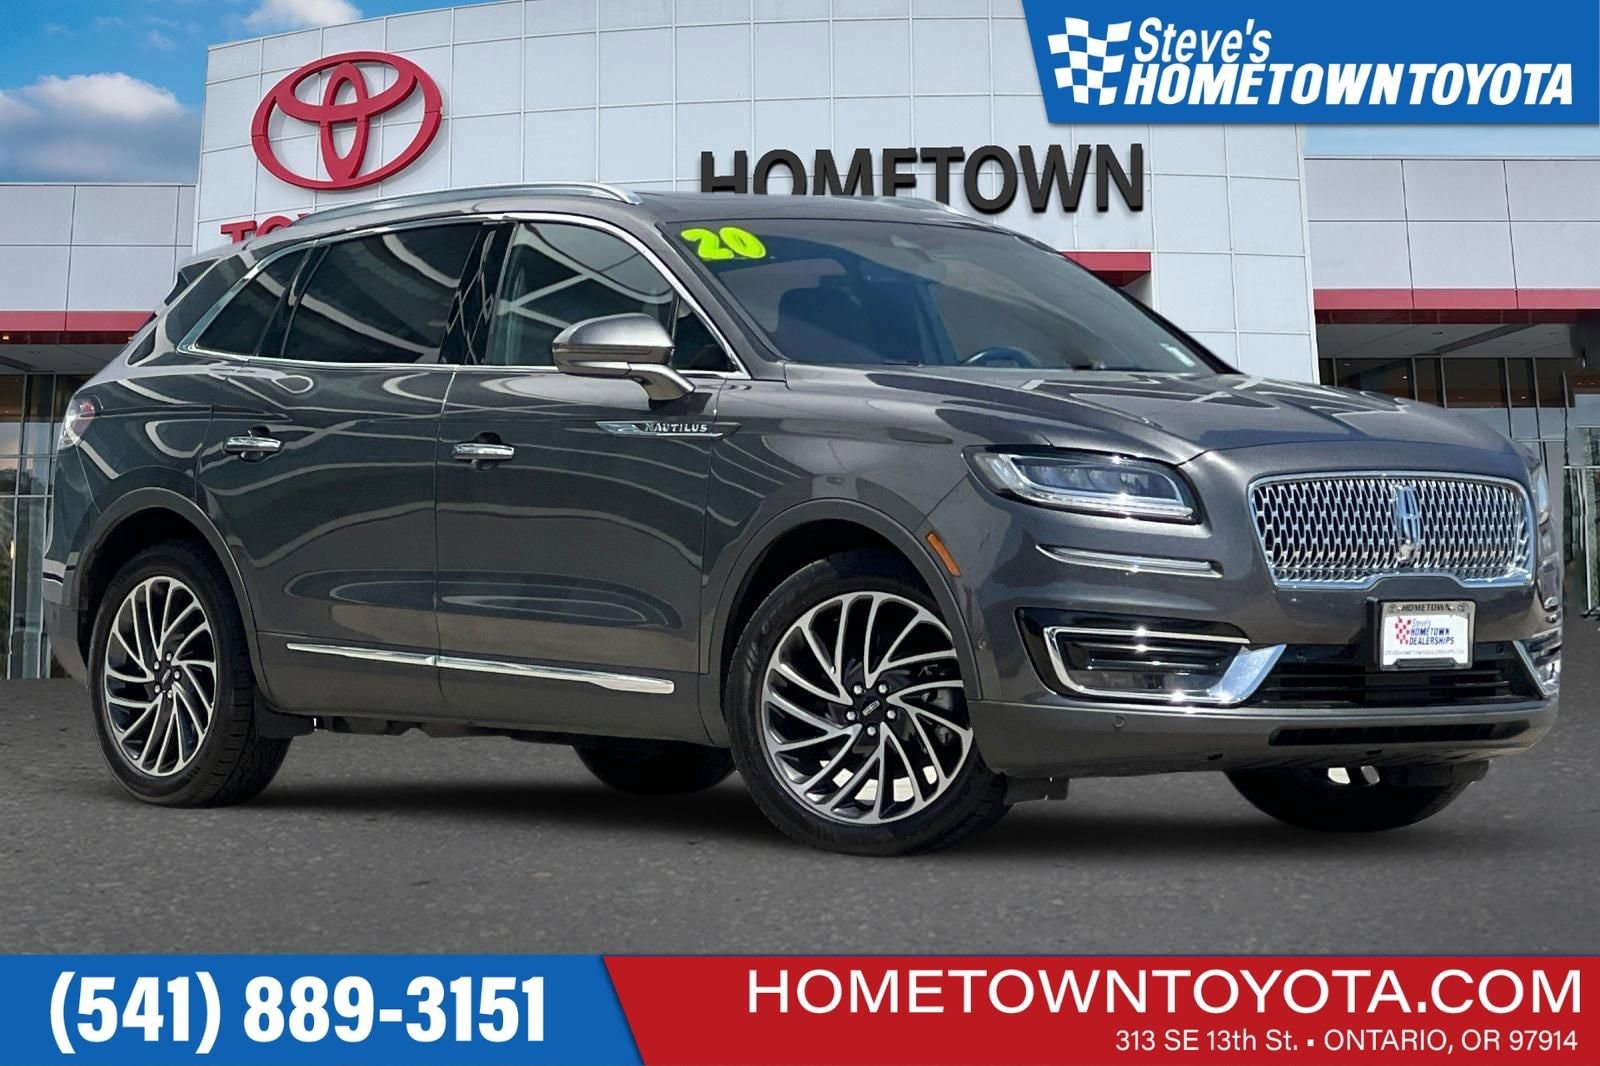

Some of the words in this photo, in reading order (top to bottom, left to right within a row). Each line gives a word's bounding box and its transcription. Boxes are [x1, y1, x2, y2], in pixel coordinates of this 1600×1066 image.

[700, 143, 1144, 214] HOMETOWN
[680, 226, 767, 260] 20
[645, 422, 708, 433] NAUTILUS
[1410, 627, 1450, 636] HOMETOWN
[1409, 636, 1455, 646] DEALERSHIPS
